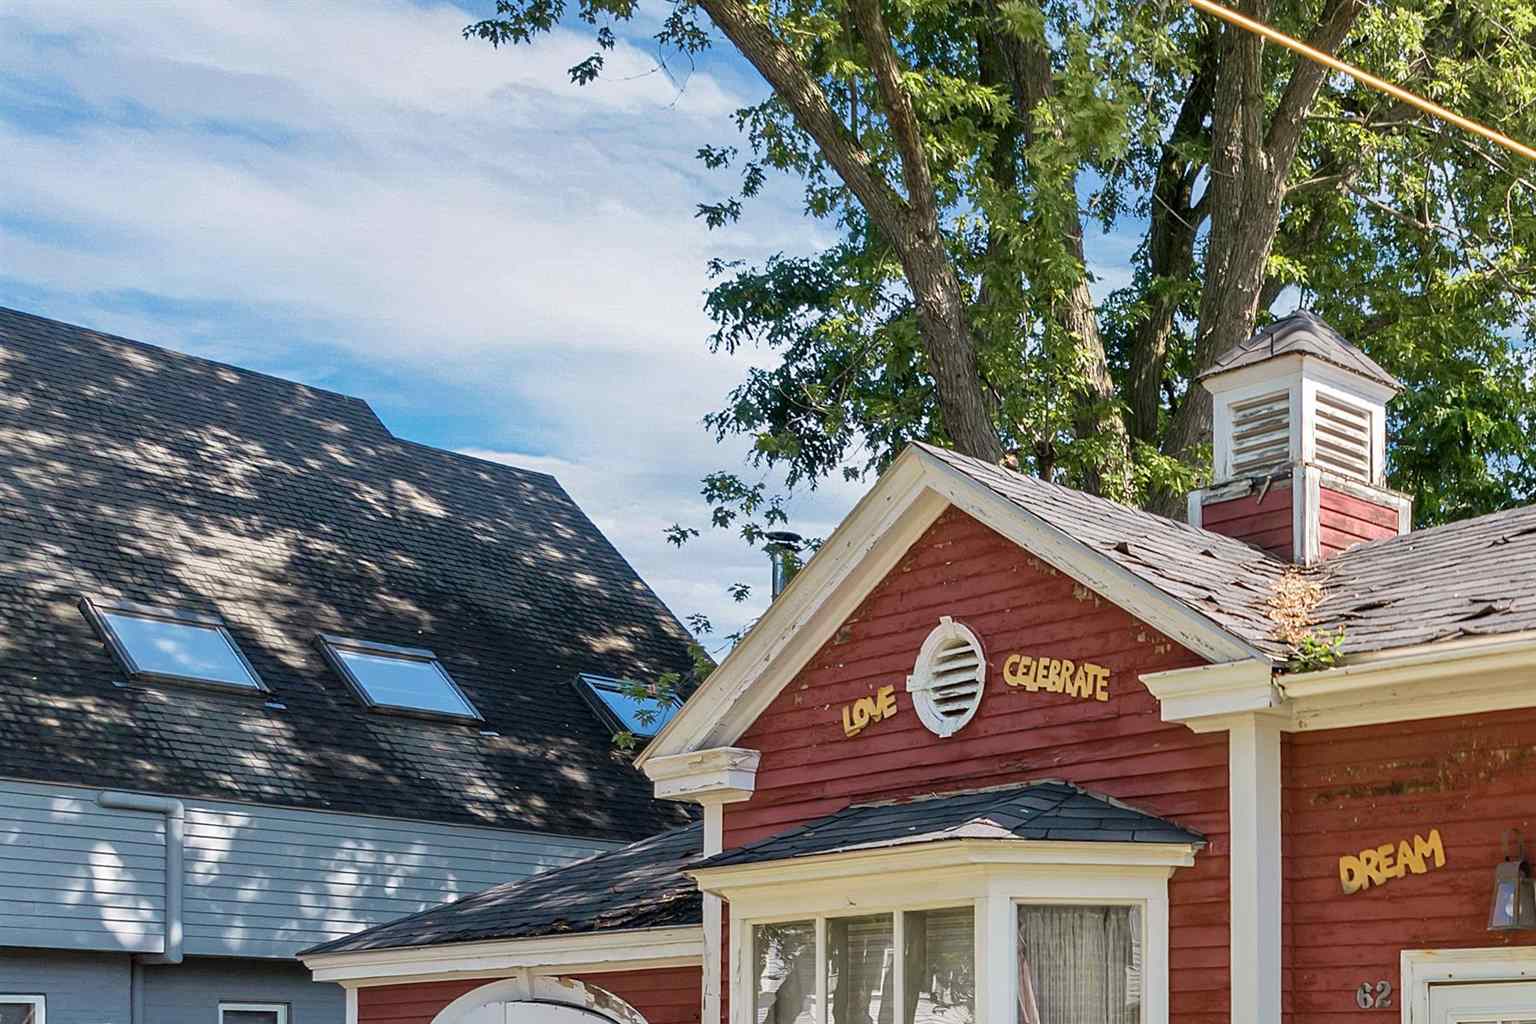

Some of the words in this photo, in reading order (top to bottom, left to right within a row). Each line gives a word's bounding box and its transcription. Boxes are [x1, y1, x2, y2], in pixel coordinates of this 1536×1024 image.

[1003, 654, 1111, 702] CELEBRATE
[841, 685, 898, 737] LOVE
[1339, 829, 1446, 895] DREAM
[1357, 981, 1391, 1008] 62
